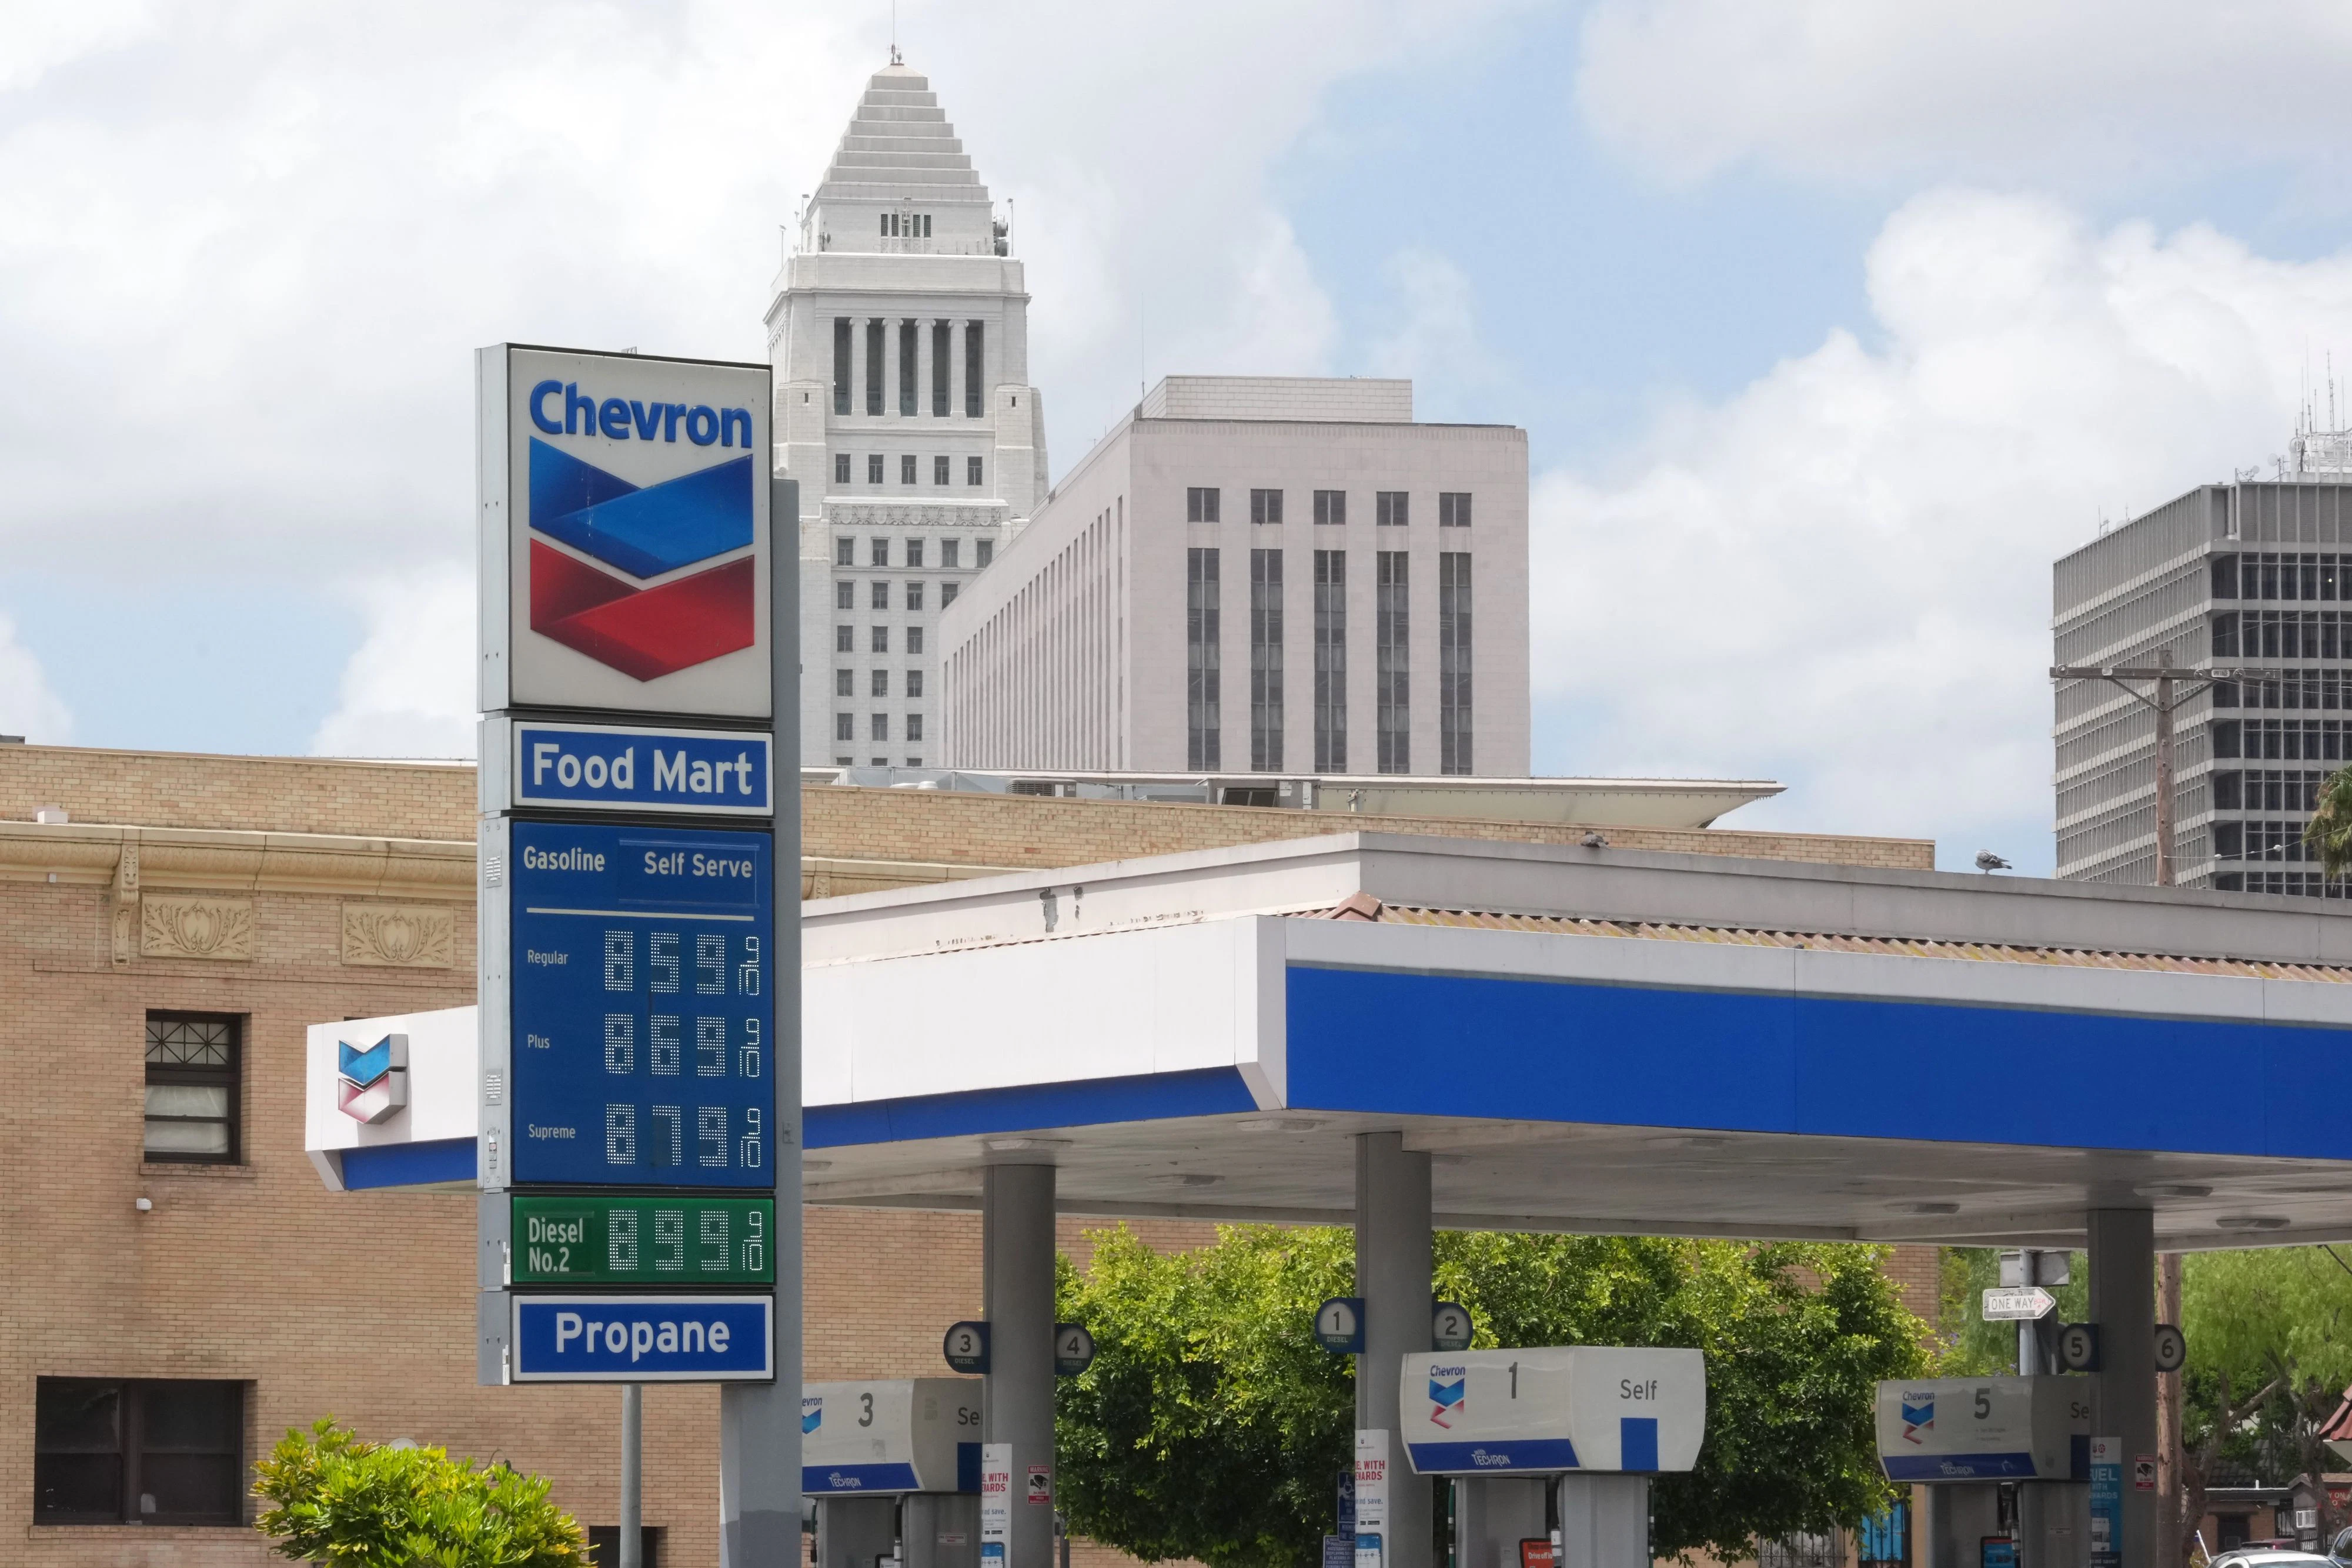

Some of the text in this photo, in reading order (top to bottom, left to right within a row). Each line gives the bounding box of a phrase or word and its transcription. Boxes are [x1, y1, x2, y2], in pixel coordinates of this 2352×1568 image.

[530, 380, 753, 449] Chevron
[533, 743, 753, 794] Food Mart
[524, 845, 605, 872] Gasoline
[644, 851, 752, 878] Self Serve
[527, 949, 568, 967] Regular
[605, 931, 725, 995] 859
[527, 1034, 550, 1049] Plus
[605, 1014, 726, 1076] 869
[529, 1124, 576, 1139] Supreme
[529, 1216, 583, 1243] Diesel
[609, 1210, 729, 1271] 899
[1992, 1298, 2010, 1310] ONE
[2014, 1297, 2034, 1309] WAY
[1333, 1311, 1340, 1331] 1
[1445, 1316, 1458, 1336] 2
[556, 1312, 730, 1363] Propane
[959, 1334, 971, 1353] 3
[1067, 1336, 1080, 1355] 4
[2071, 1336, 2083, 1358] 5
[2161, 1338, 2174, 1359] 6
[1430, 1365, 1466, 1377] Chevron
[1508, 1362, 1518, 1399] 1
[1620, 1379, 1658, 1400] Self
[1903, 1391, 1935, 1401] Chevron
[802, 1396, 823, 1407] evron
[858, 1392, 874, 1427] 3
[1973, 1388, 1991, 1420] 5
[2071, 1402, 2089, 1419] Se
[957, 1406, 983, 1426] Se
[1364, 1460, 1385, 1470] WITH
[1471, 1453, 1511, 1467] TECHRON
[828, 1476, 861, 1488] TECHRON
[988, 1473, 1008, 1482] WITH
[1355, 1471, 1382, 1480] EWARDS
[2090, 1467, 2117, 1481] UEL
